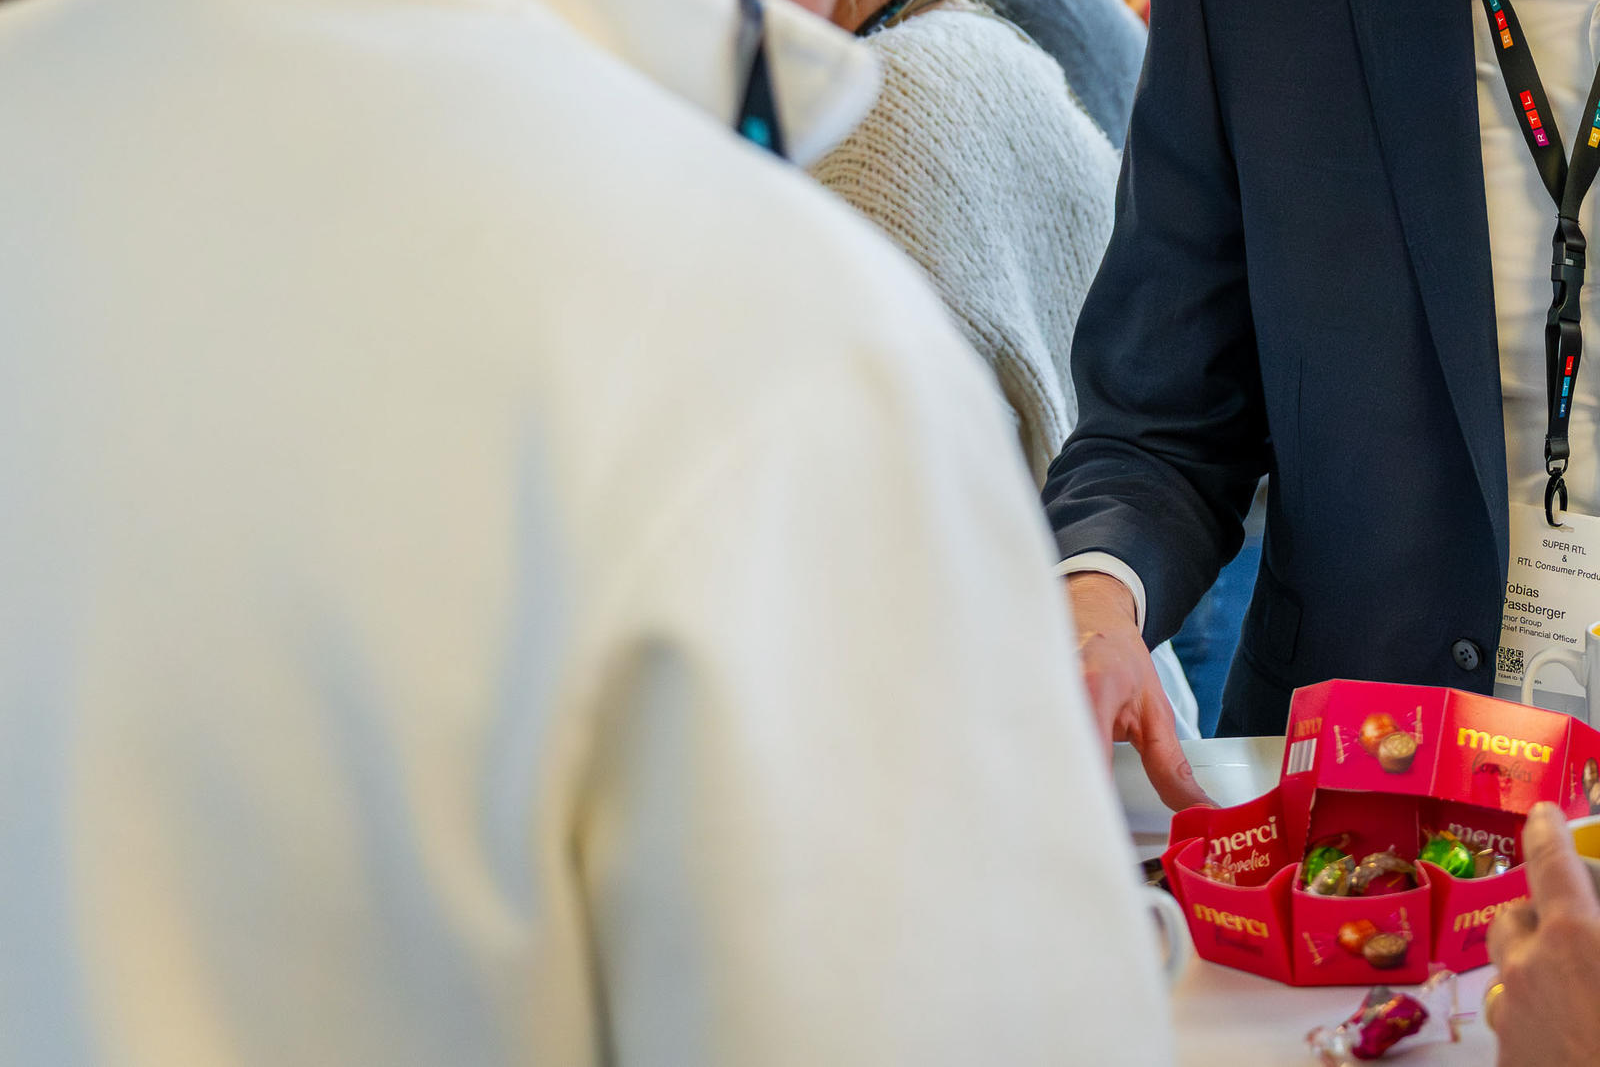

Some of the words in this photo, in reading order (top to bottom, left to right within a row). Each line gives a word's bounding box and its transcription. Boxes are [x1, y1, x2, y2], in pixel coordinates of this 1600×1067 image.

[1523, 95, 1546, 143] RTL
[1542, 539, 1570, 552] SUPER
[1571, 544, 1587, 555] RTL
[1561, 554, 1568, 563] &
[1517, 556, 1533, 567] RTL
[1535, 560, 1576, 576] Consumer
[1518, 626, 1551, 639] Financial
[1552, 633, 1578, 644] Officer
[1519, 616, 1543, 628] Group
[1457, 726, 1554, 764] merci
[1210, 815, 1278, 856] merci
[1448, 822, 1515, 856] merc
[1193, 903, 1269, 938] merci
